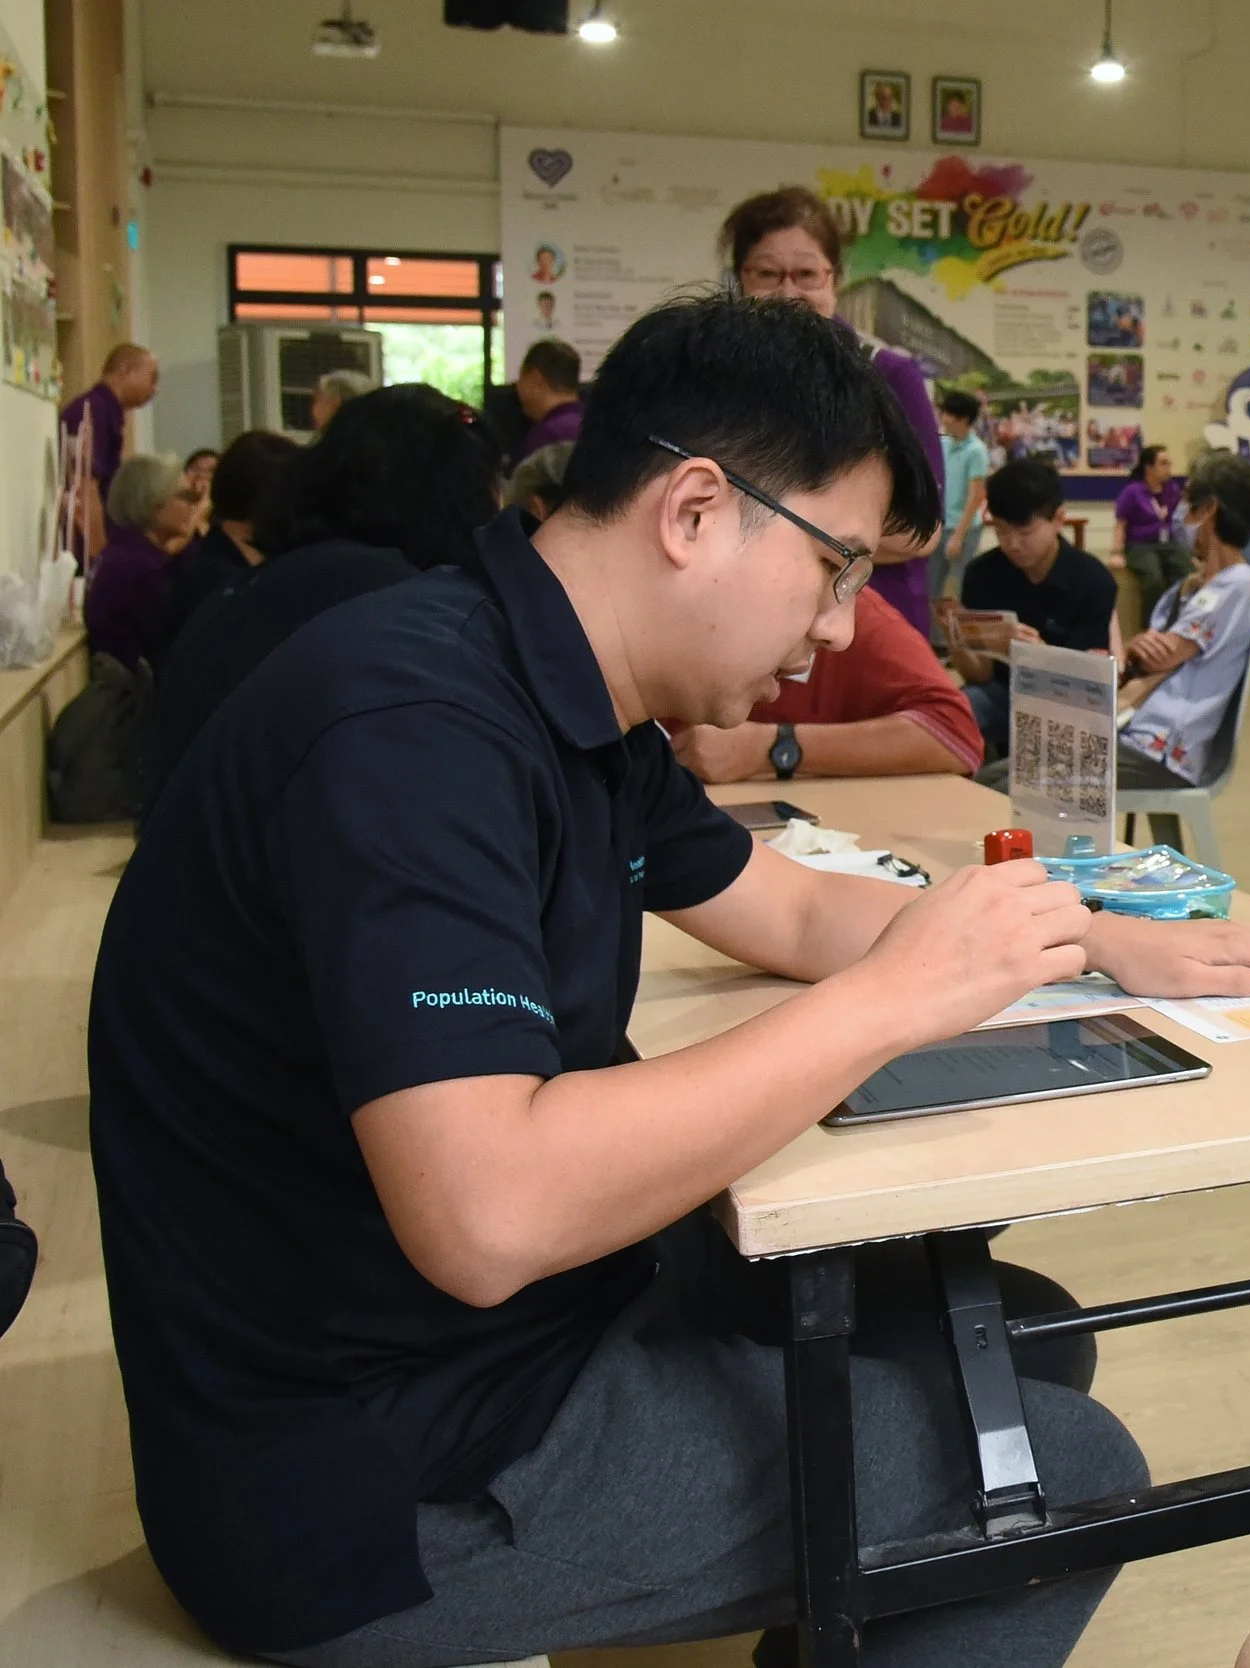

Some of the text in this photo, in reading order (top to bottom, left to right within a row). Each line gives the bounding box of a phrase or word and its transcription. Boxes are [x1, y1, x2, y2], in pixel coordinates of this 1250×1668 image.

[887, 200, 955, 240] SET
[965, 193, 1091, 249] Gold!
[411, 987, 517, 1009] Population
